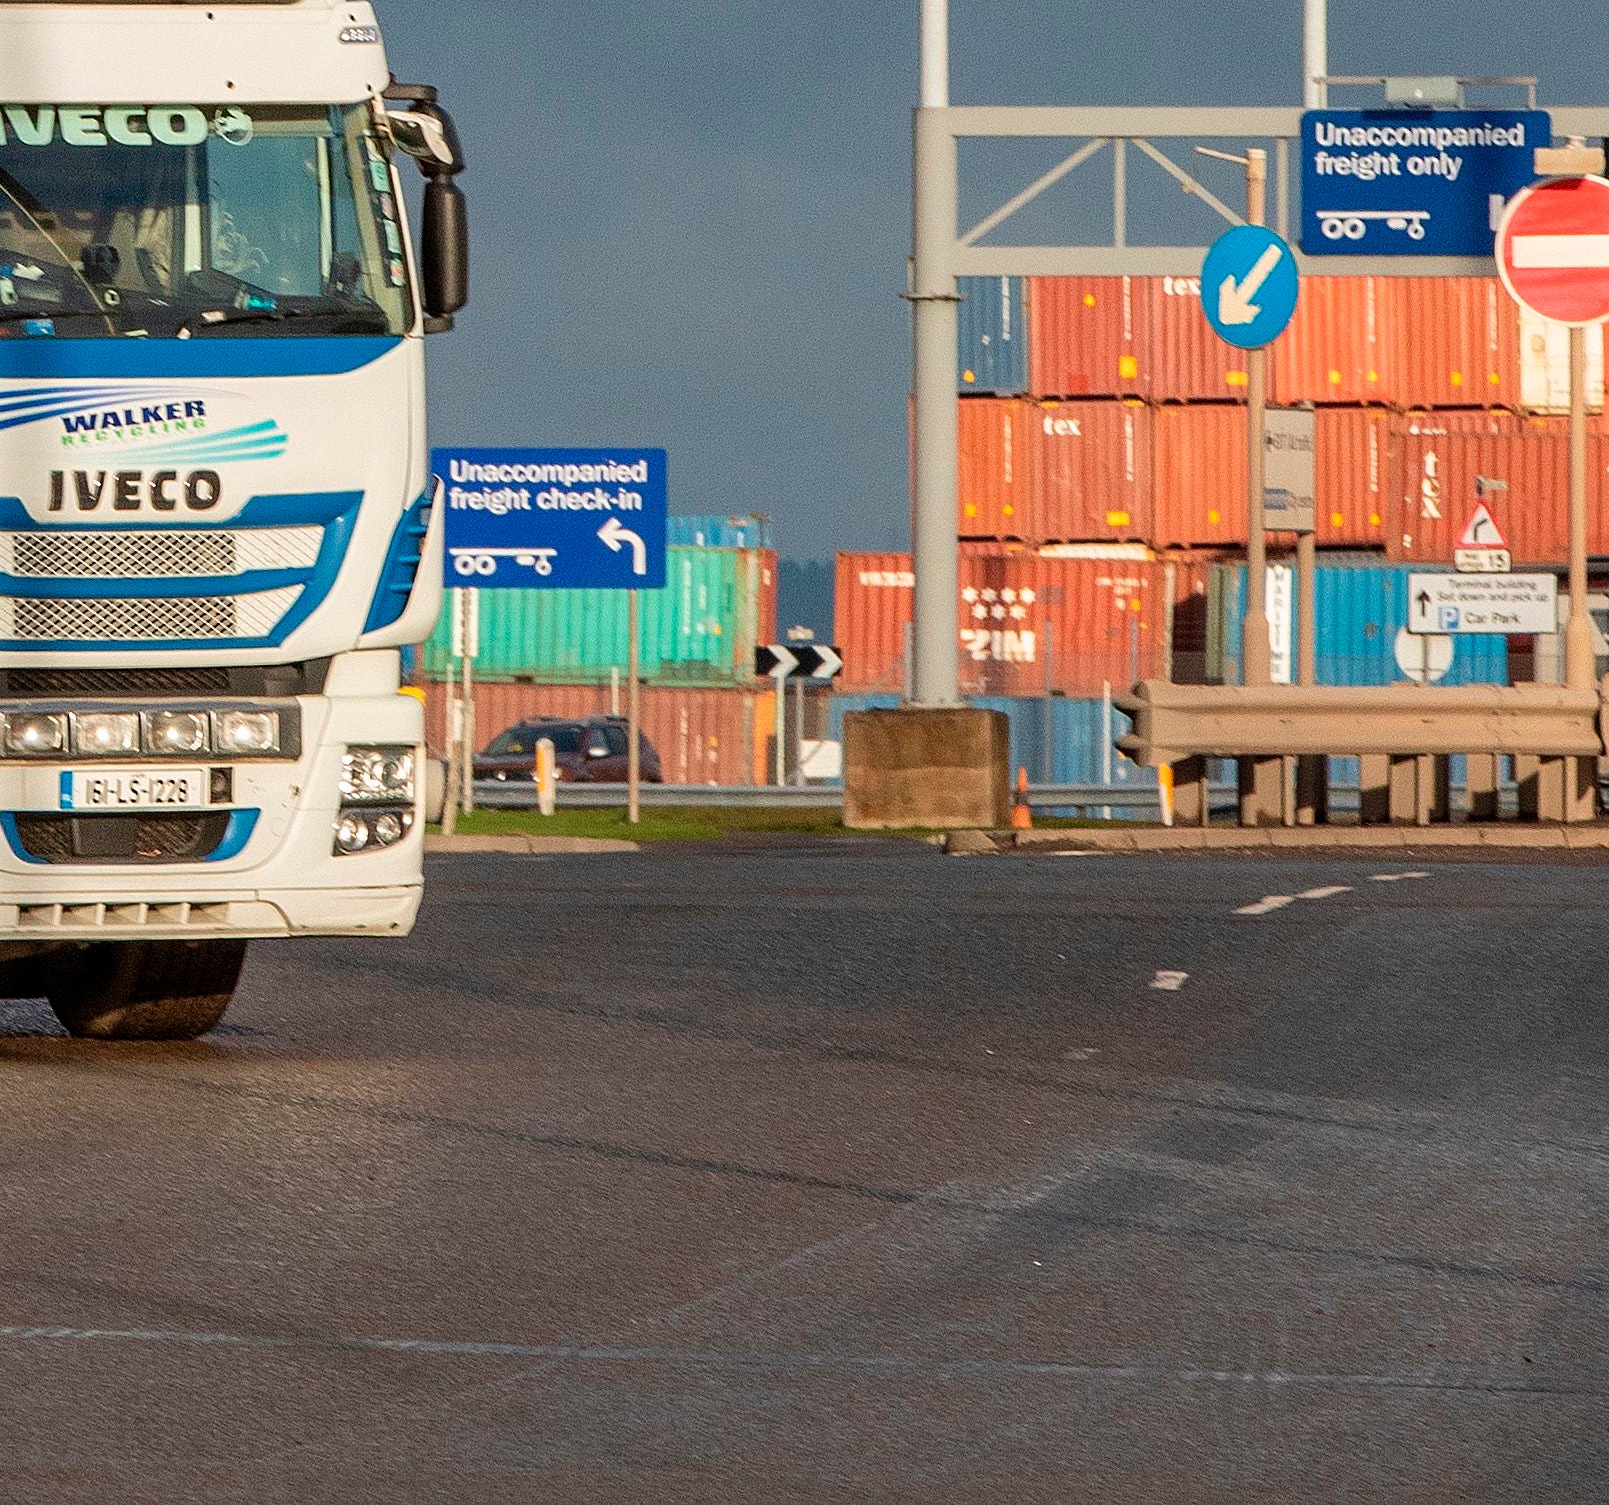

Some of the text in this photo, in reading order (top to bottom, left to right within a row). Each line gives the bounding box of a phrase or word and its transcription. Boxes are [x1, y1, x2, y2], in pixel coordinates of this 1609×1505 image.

[1314, 121, 1525, 151] Unaccompanied
[1314, 151, 1463, 182] freight only
[59, 399, 207, 434] WALKER
[1042, 415, 1082, 436] tex
[60, 418, 207, 446] RECYCLING
[449, 458, 649, 487] Unaccompanied
[47, 469, 221, 512] IVECO
[449, 487, 643, 515] freight check-in
[1464, 612, 1521, 625] Car Park
[959, 629, 1036, 663] ZIM
